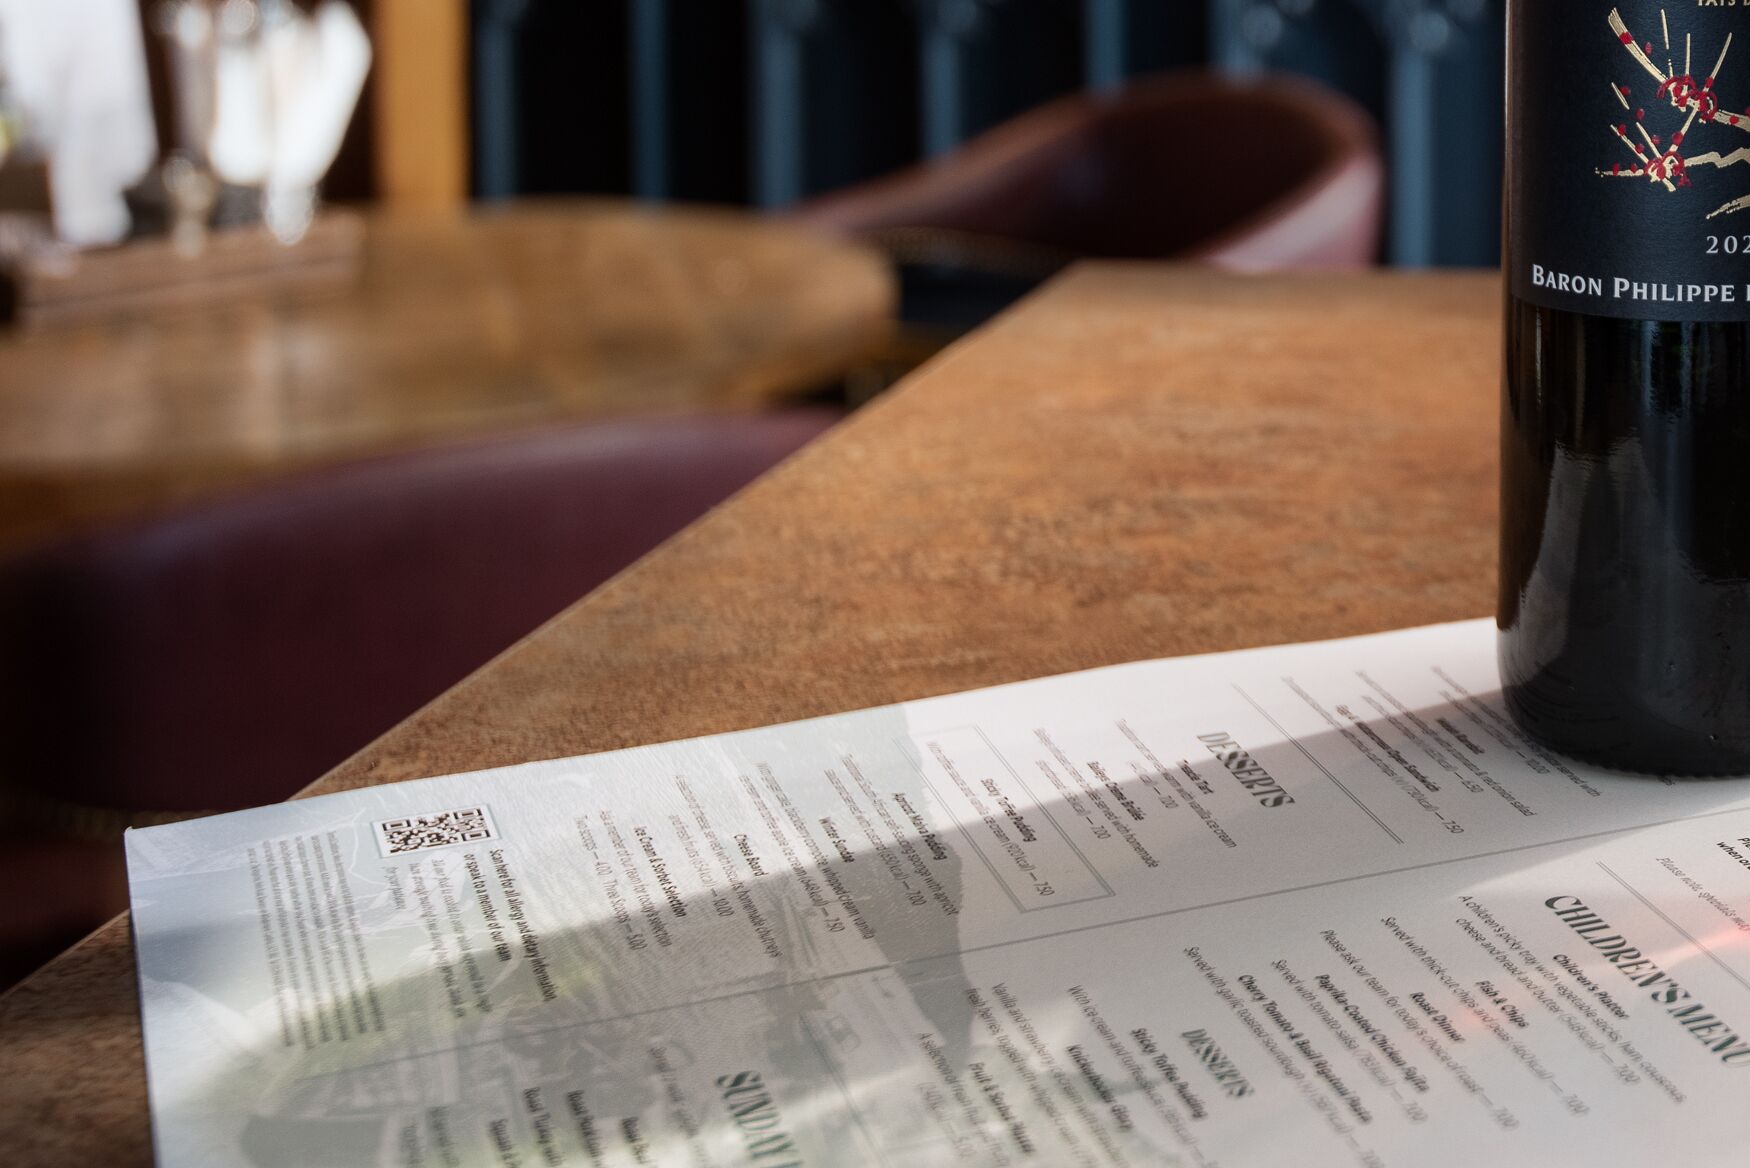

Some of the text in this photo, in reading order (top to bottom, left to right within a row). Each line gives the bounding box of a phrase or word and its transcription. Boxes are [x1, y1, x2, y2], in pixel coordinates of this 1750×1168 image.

[1532, 264, 1602, 296] BARON
[1613, 277, 1736, 303] PHILIPPE
[1194, 779, 1214, 795] Tart
[1196, 731, 1296, 808] DESSERTS
[1402, 764, 1441, 793] Sandwich
[1554, 765, 1603, 797] served with
[1187, 799, 1237, 848] vanilla cream
[1490, 784, 1538, 817] onion salad
[831, 838, 856, 863] Sundae
[919, 832, 948, 861] Pudding
[1009, 815, 1037, 842] Pudding
[1122, 832, 1160, 868] homemade
[1440, 819, 1465, 834] 7.50
[1715, 840, 1743, 860] when
[637, 835, 688, 918] Cream Sorbet Selection
[732, 833, 769, 877] Cheese Board
[710, 896, 736, 917] 10.00
[819, 865, 881, 940] whipped cream, vanilla
[904, 853, 963, 917] sponge with apricot
[1032, 880, 1055, 896] 7.50
[463, 860, 512, 962] speak member team
[488, 848, 559, 1003] Scan here allergy and dietary information,
[602, 878, 648, 951] Three Scoops 5.00
[635, 893, 674, 948] today's selection
[731, 888, 787, 958] homemade chutneys
[822, 916, 846, 933] 7.50
[1182, 945, 1216, 972] Served
[1318, 928, 1390, 997] Please team
[1379, 915, 1479, 1009] Served with thick-cut chips
[1454, 917, 1564, 1014] cheese and bread butter
[1464, 901, 1622, 1043] children's picky tray with vegetable sticks,
[1543, 894, 1691, 1004] CHILDREN'S
[990, 981, 1018, 1009] Vanilla
[1065, 984, 1093, 1006] With
[1203, 969, 1228, 989] with
[1214, 987, 1245, 1010] garlic
[1269, 958, 1342, 1030] Served with tomato
[1474, 979, 1529, 1029] Fish Chips
[1551, 953, 1630, 1019] Children's Platter
[1235, 1007, 1270, 1039] toasted
[1236, 973, 1351, 1097] Cherry Tomato Basil Rigatoni
[1313, 973, 1430, 1093] Paprika-Coated Chicken Fajita
[1408, 991, 1465, 1042] Roast Dinner
[1128, 1027, 1208, 1120] Sticky Toffee Pudding
[1179, 1027, 1255, 1099] DESSERTS
[713, 1070, 795, 1161] SUNDAY
